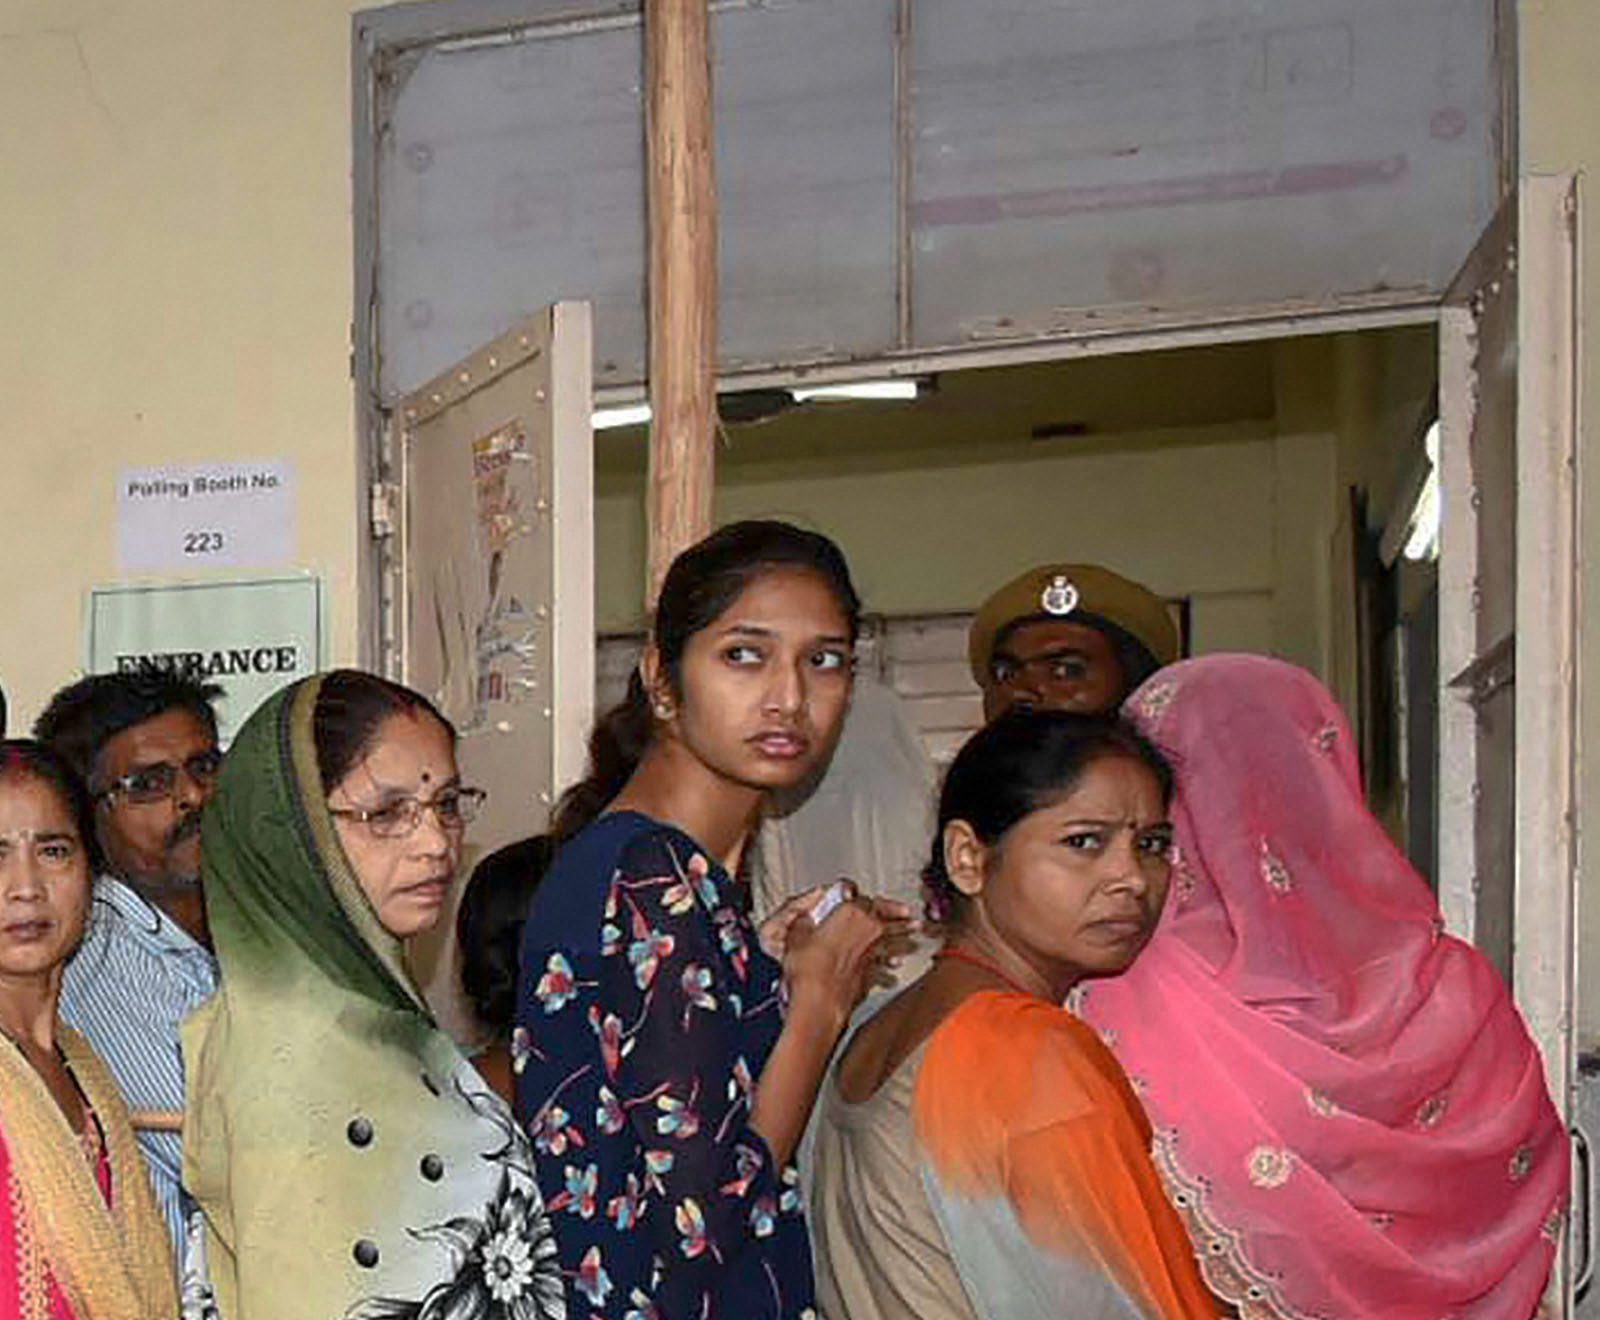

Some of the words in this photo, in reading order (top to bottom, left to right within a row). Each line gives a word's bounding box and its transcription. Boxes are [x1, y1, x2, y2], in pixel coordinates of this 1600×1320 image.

[127, 479, 190, 499] Polling
[193, 474, 248, 494] Booth
[250, 472, 281, 489] No.
[184, 532, 224, 553] 223
